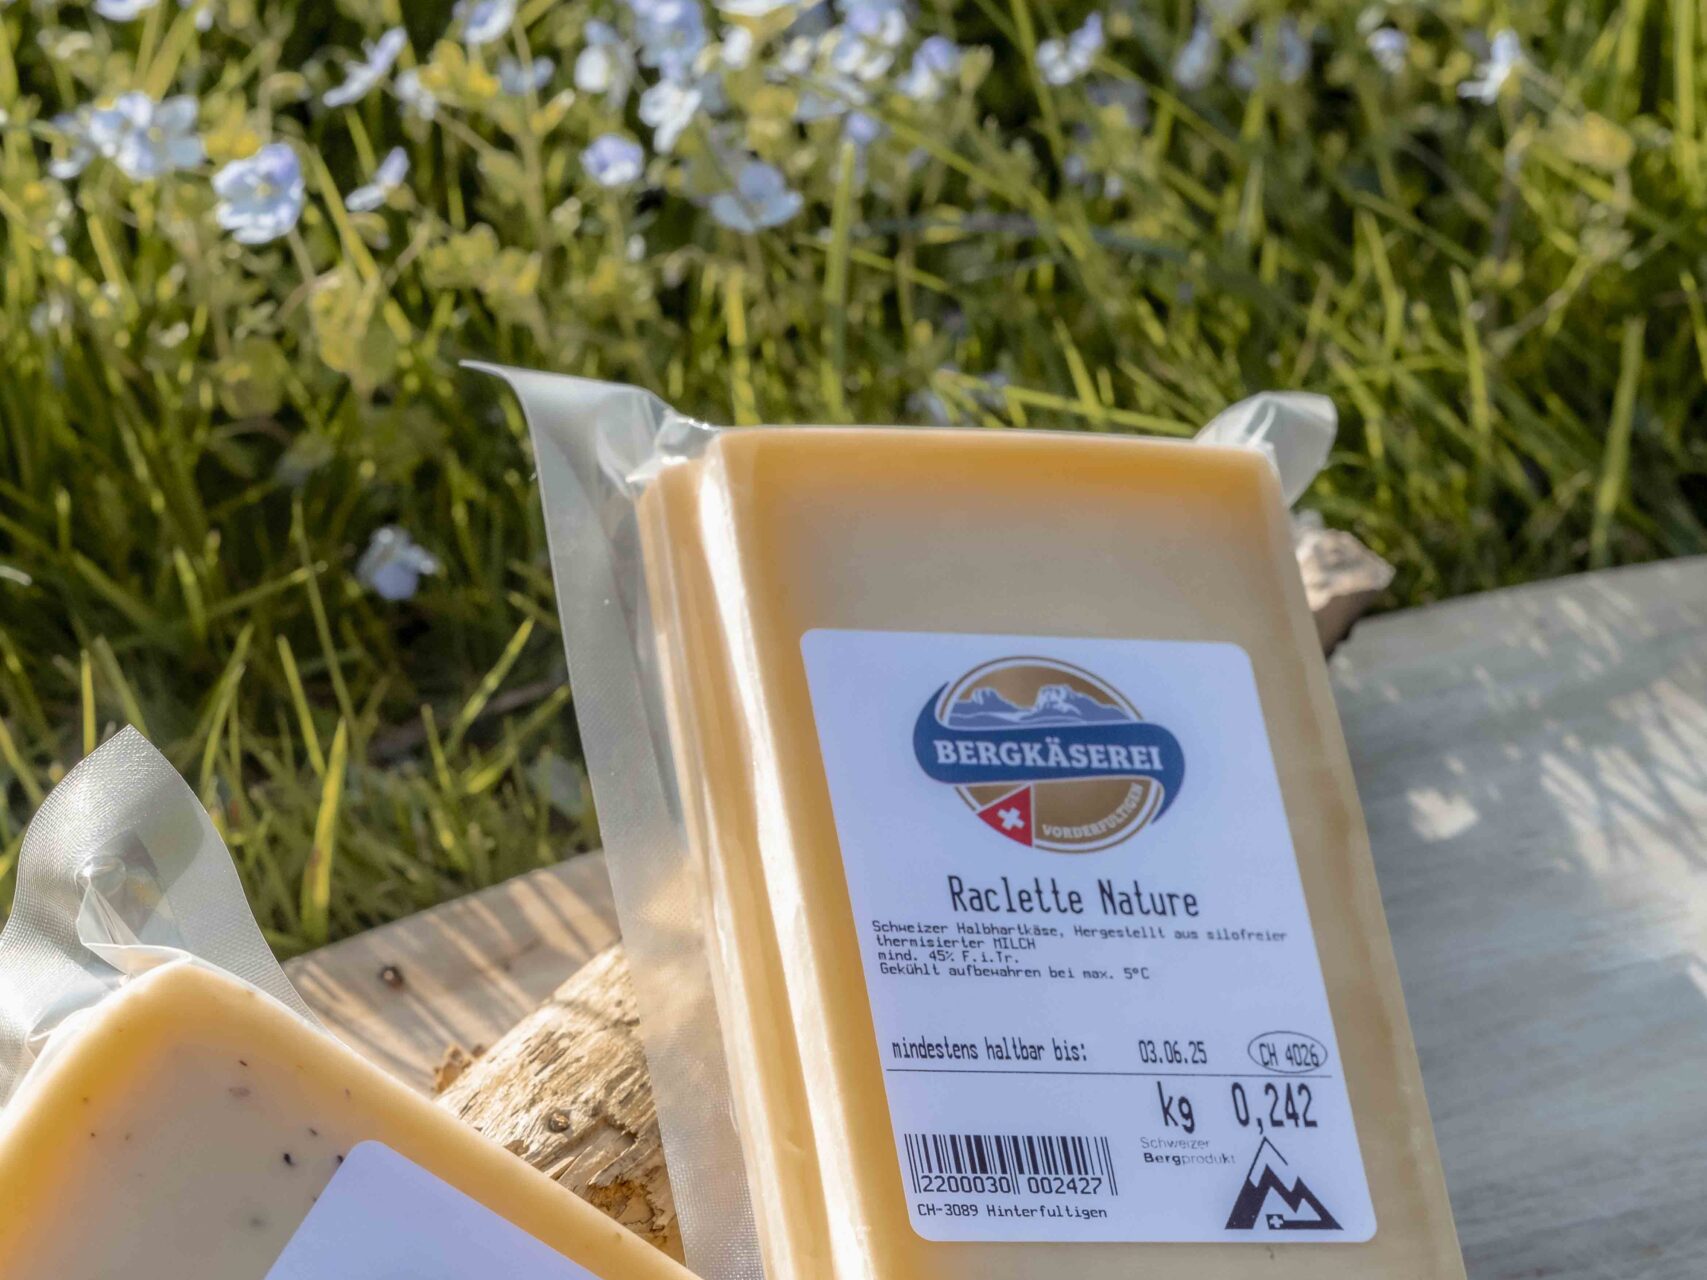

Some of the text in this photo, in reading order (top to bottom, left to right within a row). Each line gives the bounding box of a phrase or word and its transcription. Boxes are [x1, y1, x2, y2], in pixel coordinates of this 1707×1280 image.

[933, 737, 1164, 770] BERGKÄSEREI
[1042, 782, 1144, 839] VORDERFULTIGEN
[947, 875, 1199, 916] Raclette Nature
[872, 920, 1287, 942] Schweizer Halbhartkäse, Hergestellt aus silofreier
[876, 935, 1036, 950] thermisierter MILCH
[878, 950, 918, 962] mind.
[929, 950, 955, 963] 45%
[880, 962, 940, 976] Gekühlt
[949, 964, 1041, 978] aufbewahren
[1050, 966, 1075, 979] bei
[1083, 969, 1114, 980] max.
[892, 1035, 1087, 1062] mindestens haltbar bis:
[1138, 1040, 1207, 1064] 03.06.25
[1259, 1043, 1320, 1068] CH 4026
[1156, 1081, 1318, 1135] kg 0,242
[1140, 1136, 1210, 1149] Schweizer
[1143, 1151, 1236, 1166] Bergprodukt
[921, 1175, 1103, 1195] 2200030 002427
[917, 1203, 1107, 1220] CH-3089 Hinterfultigen
